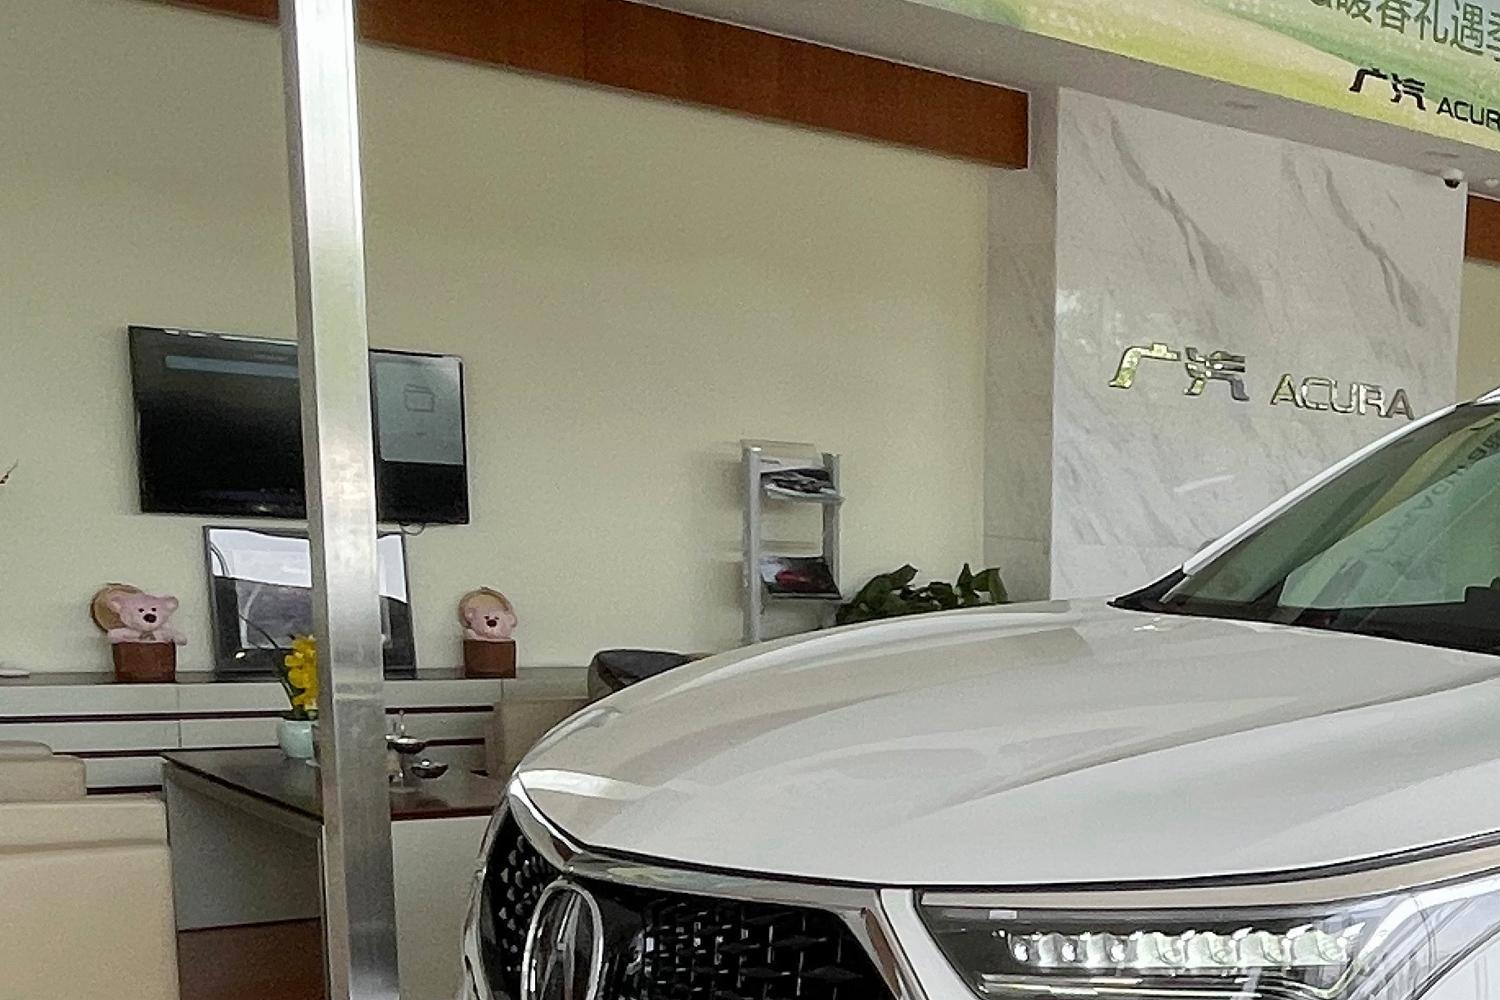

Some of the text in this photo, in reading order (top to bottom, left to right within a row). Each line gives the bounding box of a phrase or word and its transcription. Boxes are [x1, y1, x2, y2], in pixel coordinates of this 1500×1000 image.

[1349, 67, 1426, 111] 广汽
[1108, 342, 1415, 420] 广汽 ACURA
